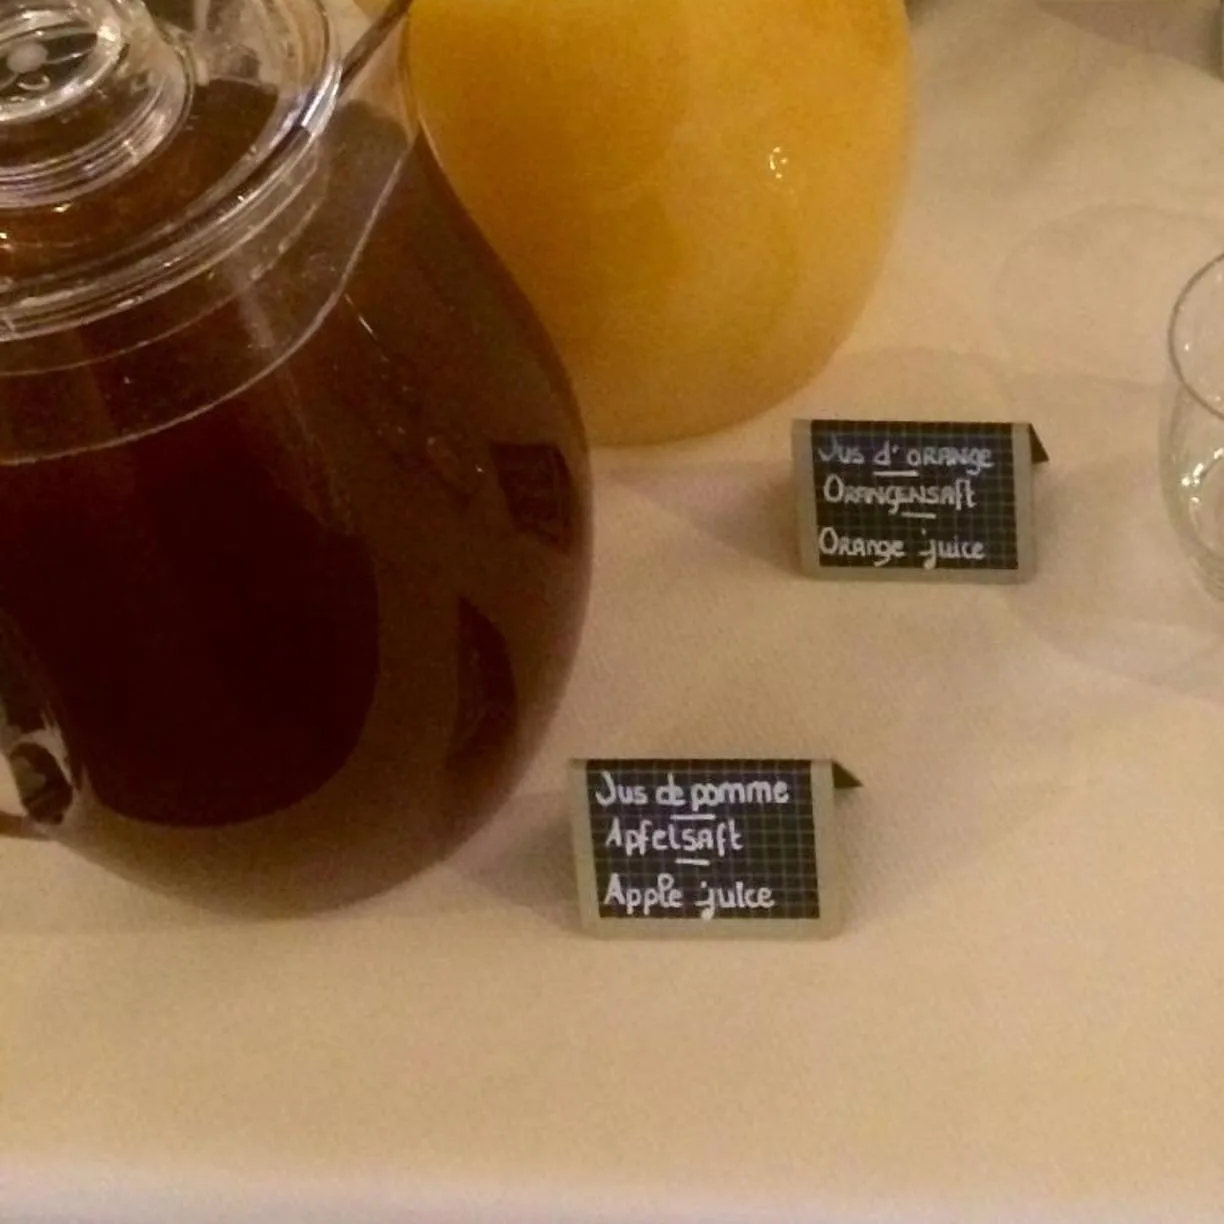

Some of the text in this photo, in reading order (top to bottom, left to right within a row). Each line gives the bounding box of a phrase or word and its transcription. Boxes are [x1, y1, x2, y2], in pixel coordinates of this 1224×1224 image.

[818, 435, 865, 465] Jus
[919, 528, 986, 570] juice
[595, 771, 790, 811] Jus de pomme
[605, 817, 744, 856] Apfelsaft
[603, 873, 776, 921] Apple juice
